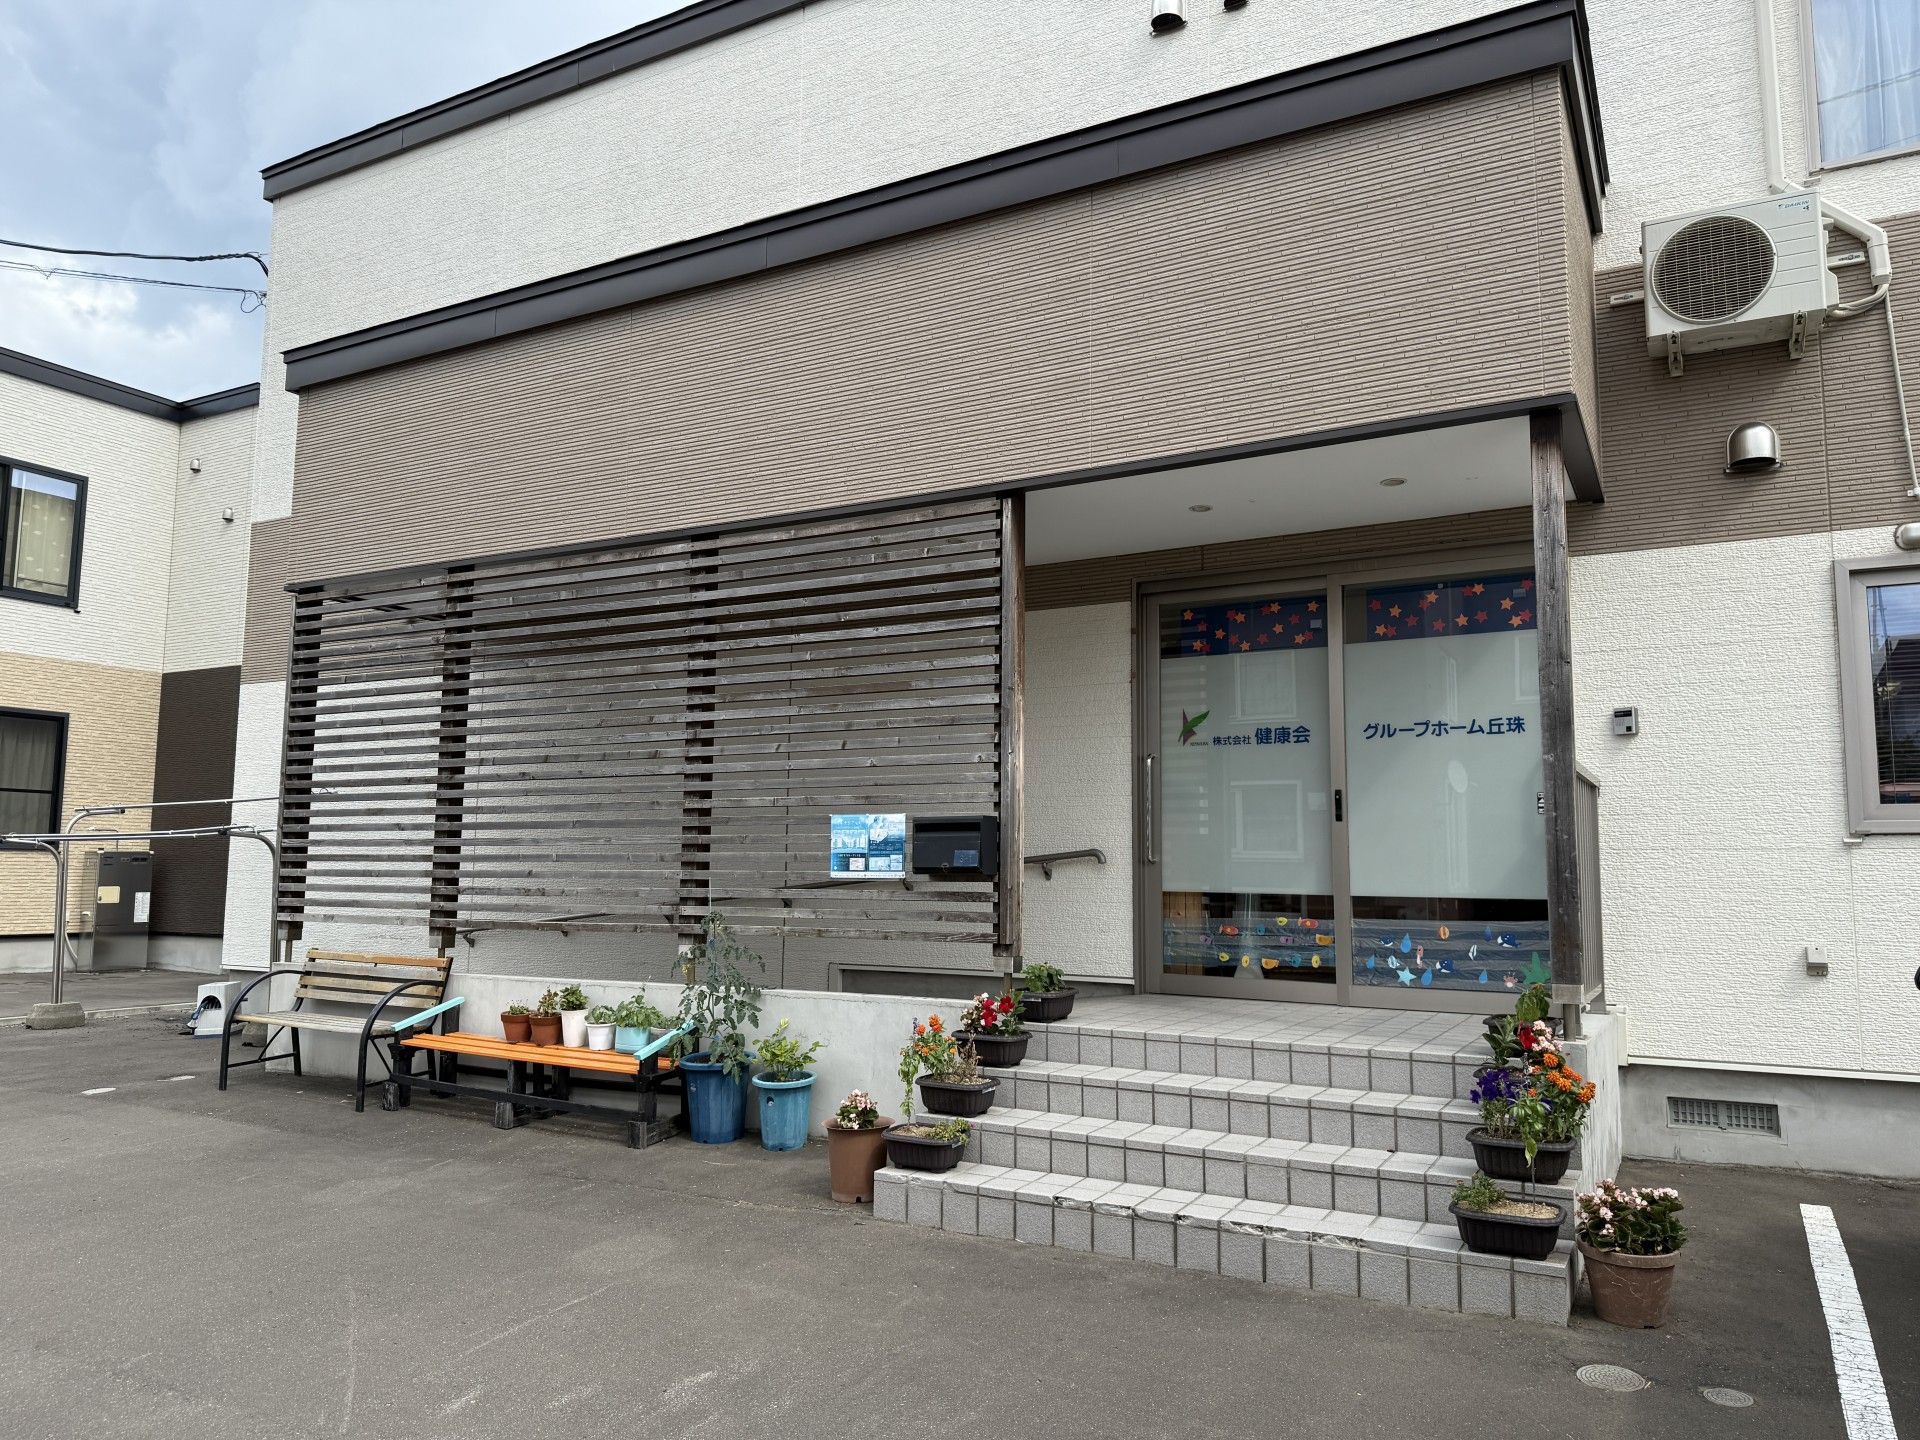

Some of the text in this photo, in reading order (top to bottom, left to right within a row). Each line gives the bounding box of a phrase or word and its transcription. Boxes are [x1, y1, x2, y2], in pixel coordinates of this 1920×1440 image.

[1363, 716, 1526, 740] グループホーム丘珠
